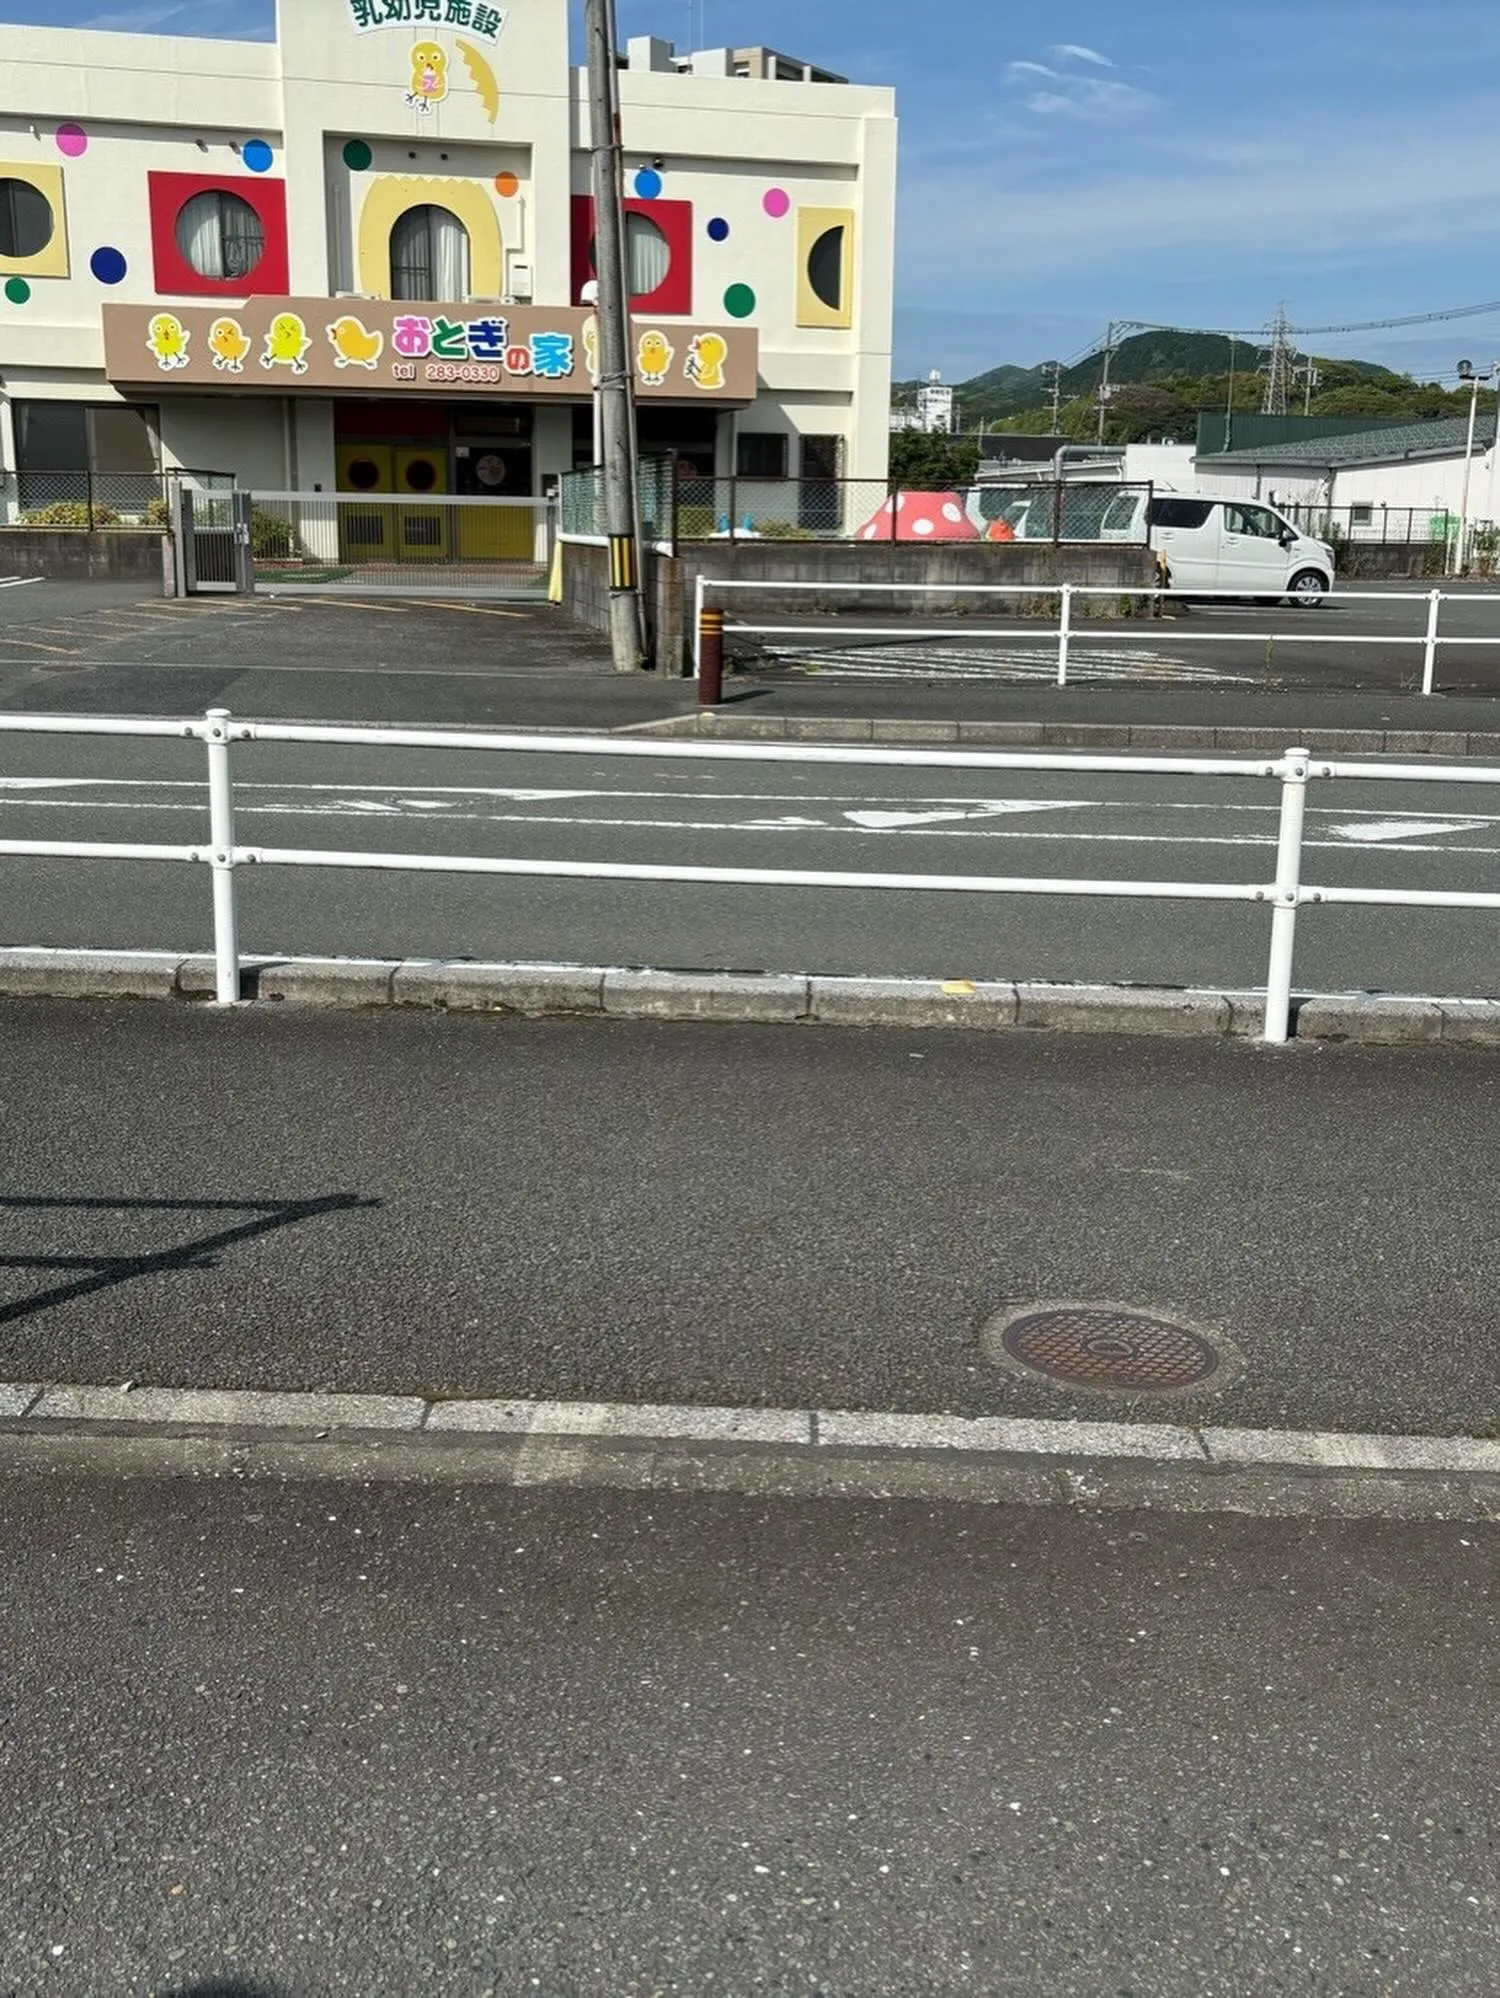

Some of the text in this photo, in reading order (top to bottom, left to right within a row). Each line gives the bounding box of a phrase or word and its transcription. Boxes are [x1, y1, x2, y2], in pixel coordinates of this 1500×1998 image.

[393, 316, 573, 376] おとぎの家
[392, 364, 500, 382] tel 283-0330
